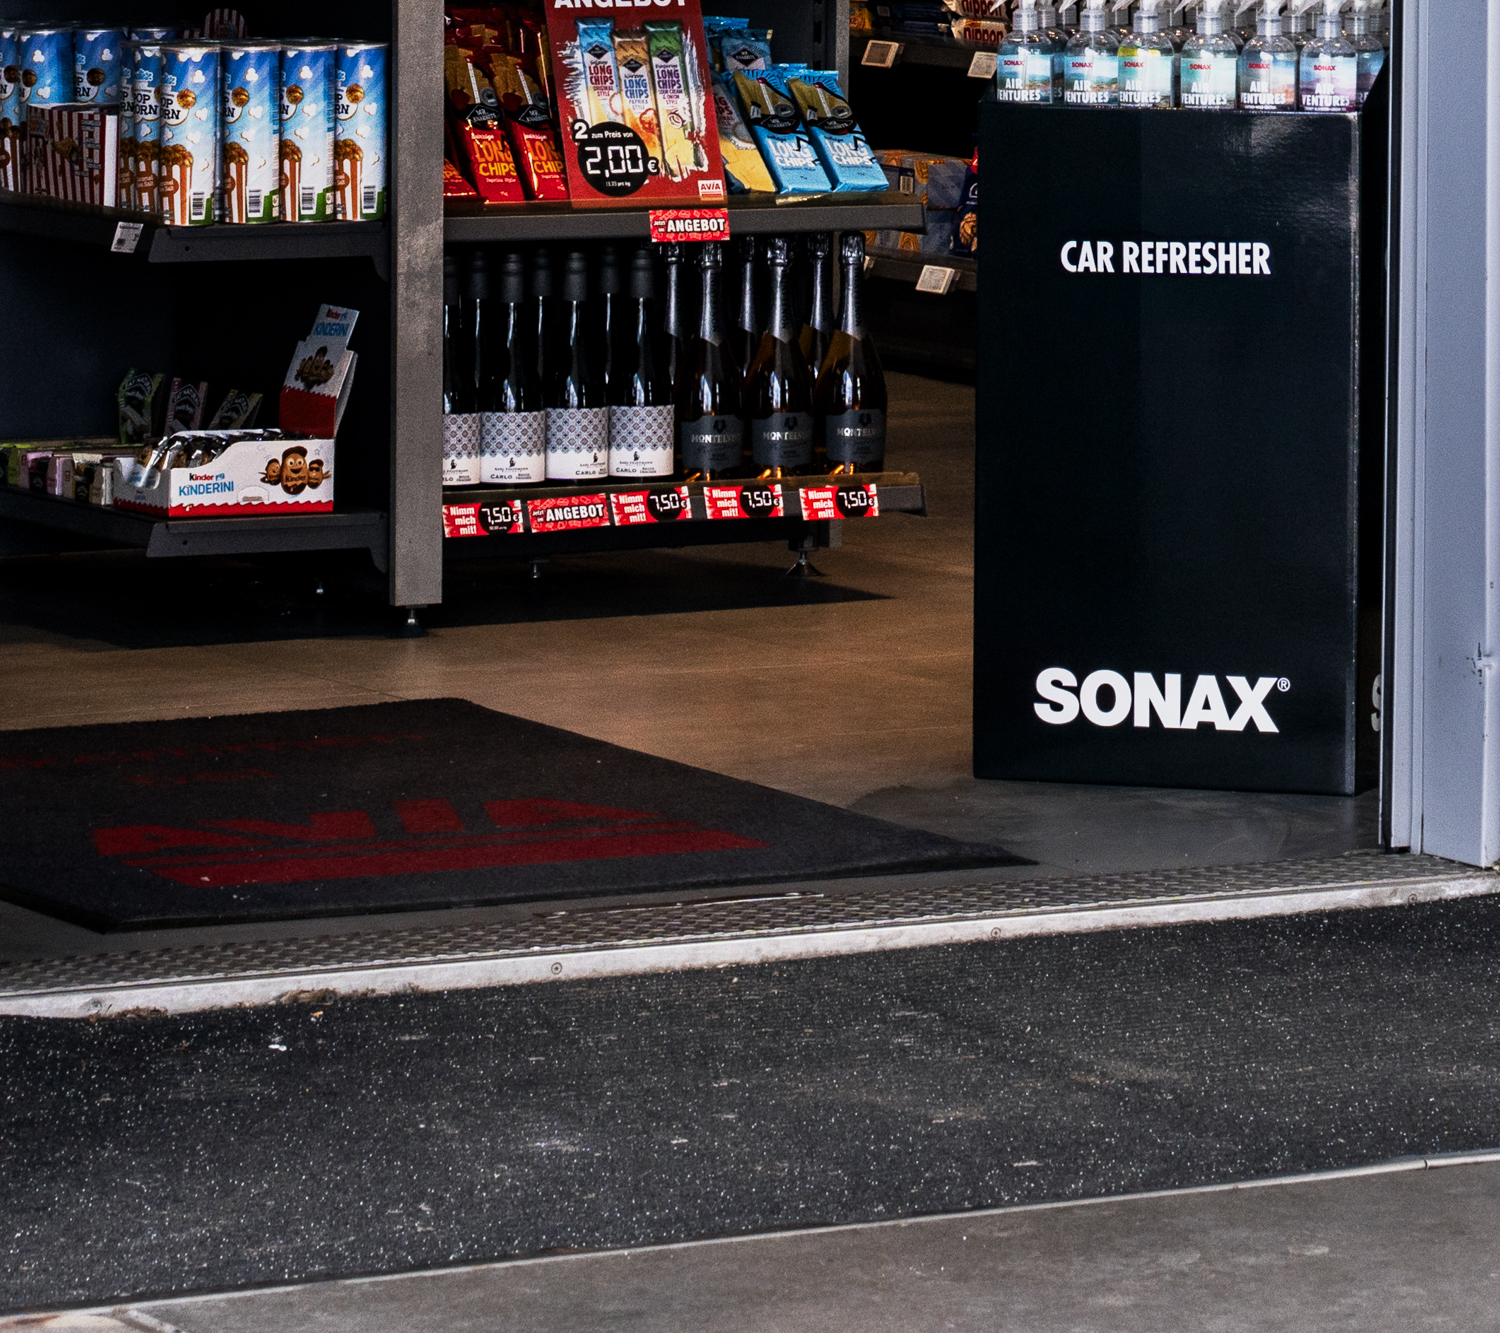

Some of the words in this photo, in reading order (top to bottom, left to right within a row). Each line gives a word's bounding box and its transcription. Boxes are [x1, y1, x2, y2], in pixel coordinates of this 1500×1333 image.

[588, 65, 612, 76] LONG
[589, 75, 615, 86] CHIPS
[1315, 82, 1334, 94] AIR
[1302, 93, 1350, 107] VENTURES
[584, 145, 644, 178] 2,00
[647, 159, 658, 173] €
[1060, 240, 1115, 273] CAR
[1122, 240, 1271, 276] REFRESHER
[709, 489, 731, 499] Nimm
[1033, 667, 1280, 733] SONAX
